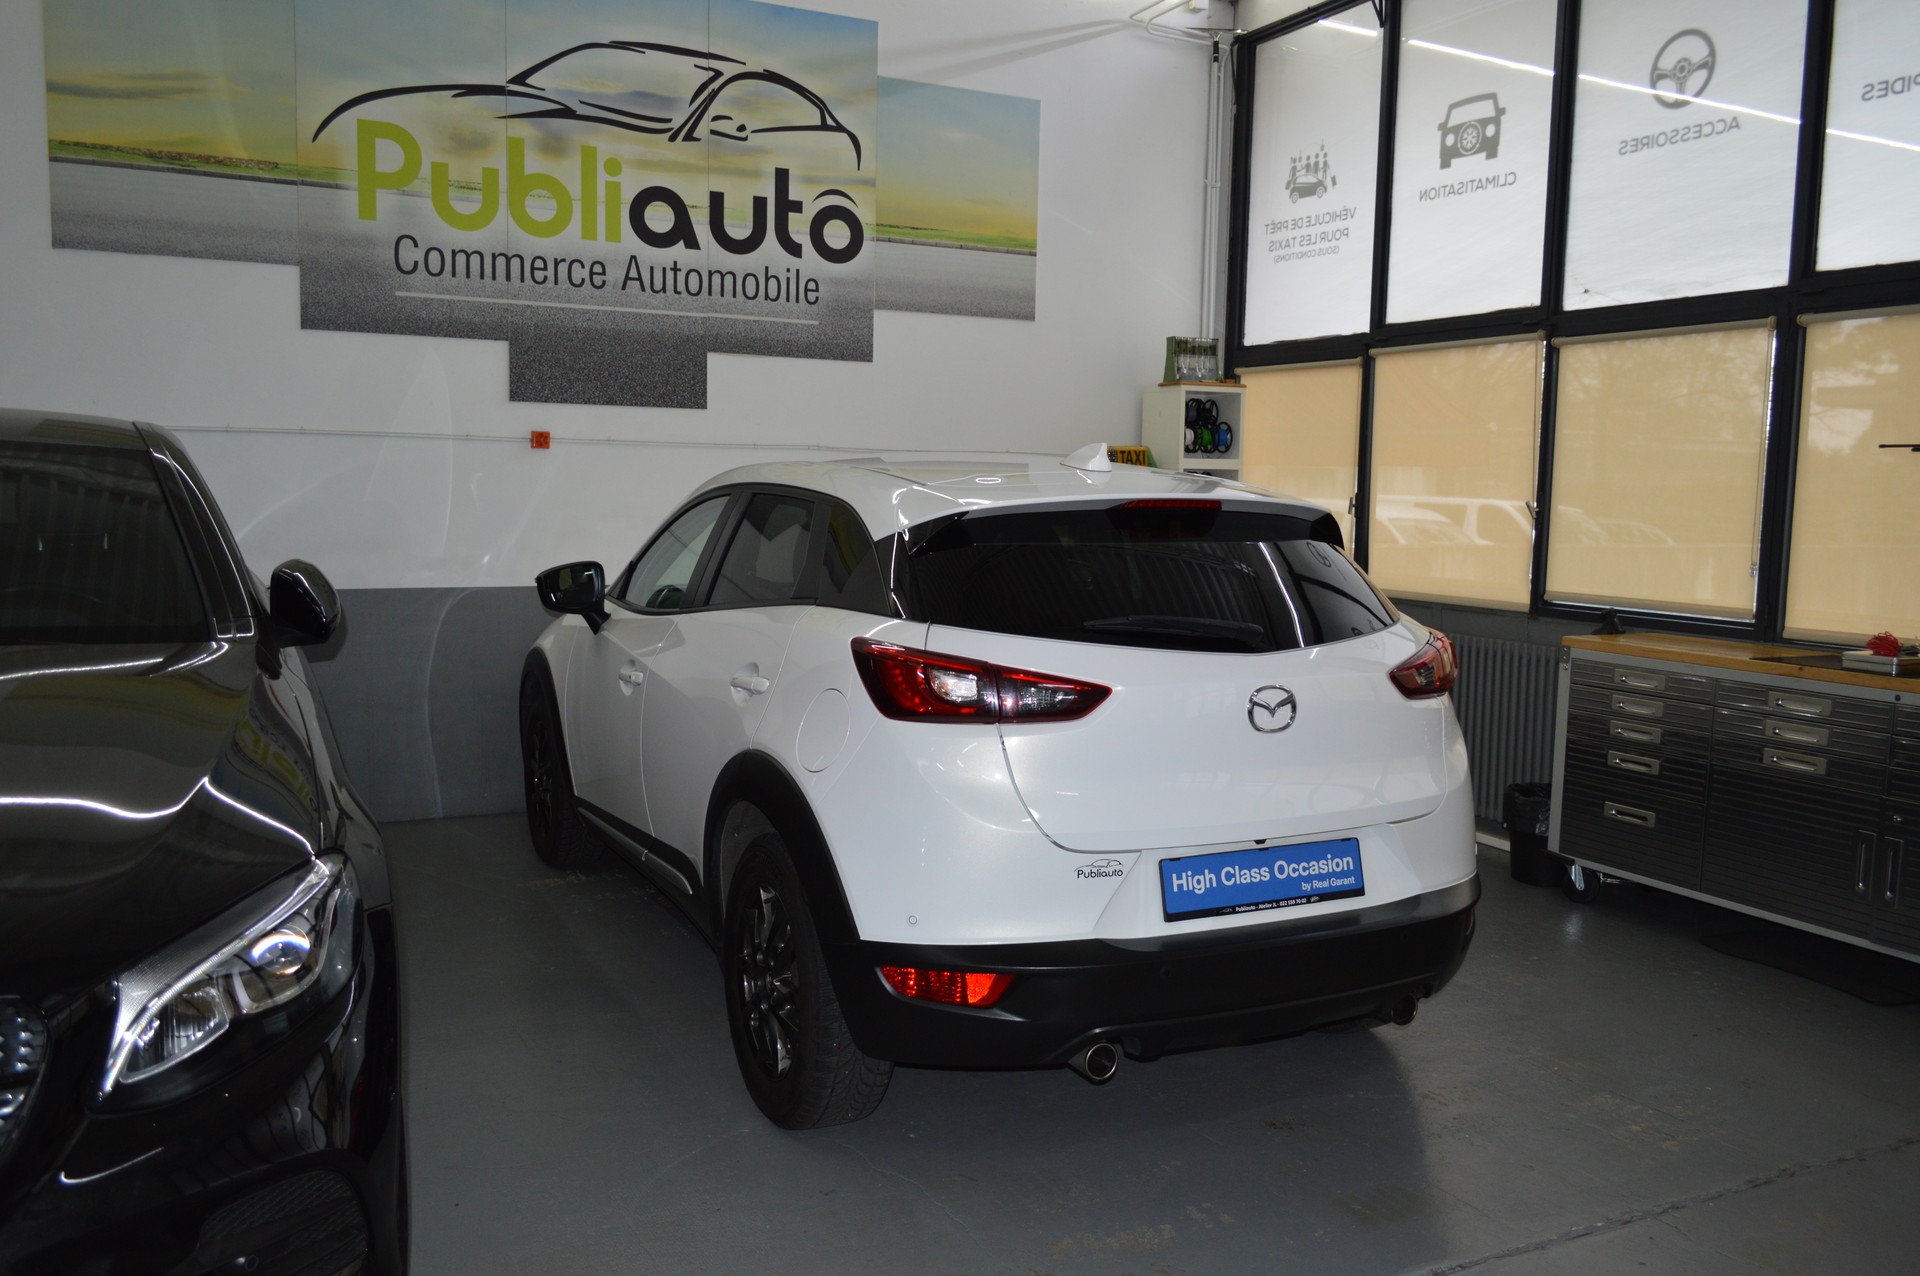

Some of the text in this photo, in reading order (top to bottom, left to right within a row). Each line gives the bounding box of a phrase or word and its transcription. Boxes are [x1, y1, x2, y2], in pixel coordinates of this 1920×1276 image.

[393, 233, 821, 305] Commerce Automobile
[1119, 450, 1146, 466] TAXI
[1077, 868, 1123, 879] Publiauto
[1171, 853, 1354, 895] High Class Occasion
[1301, 875, 1355, 892] by Real Garant
[1235, 904, 1256, 912] Publiauto
